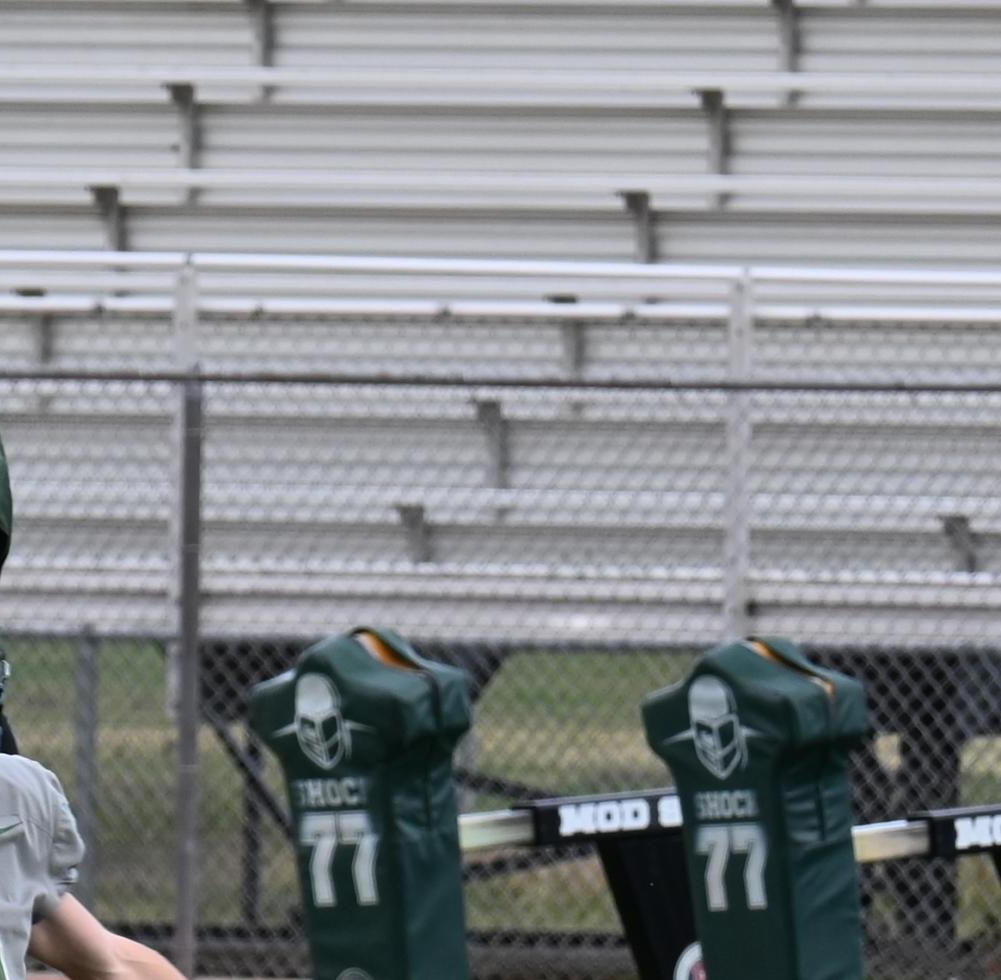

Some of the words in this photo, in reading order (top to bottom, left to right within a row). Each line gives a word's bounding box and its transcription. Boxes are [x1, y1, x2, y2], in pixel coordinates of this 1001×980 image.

[300, 811, 379, 907] 77
[558, 798, 650, 837] MOD
[696, 823, 769, 911] 77
